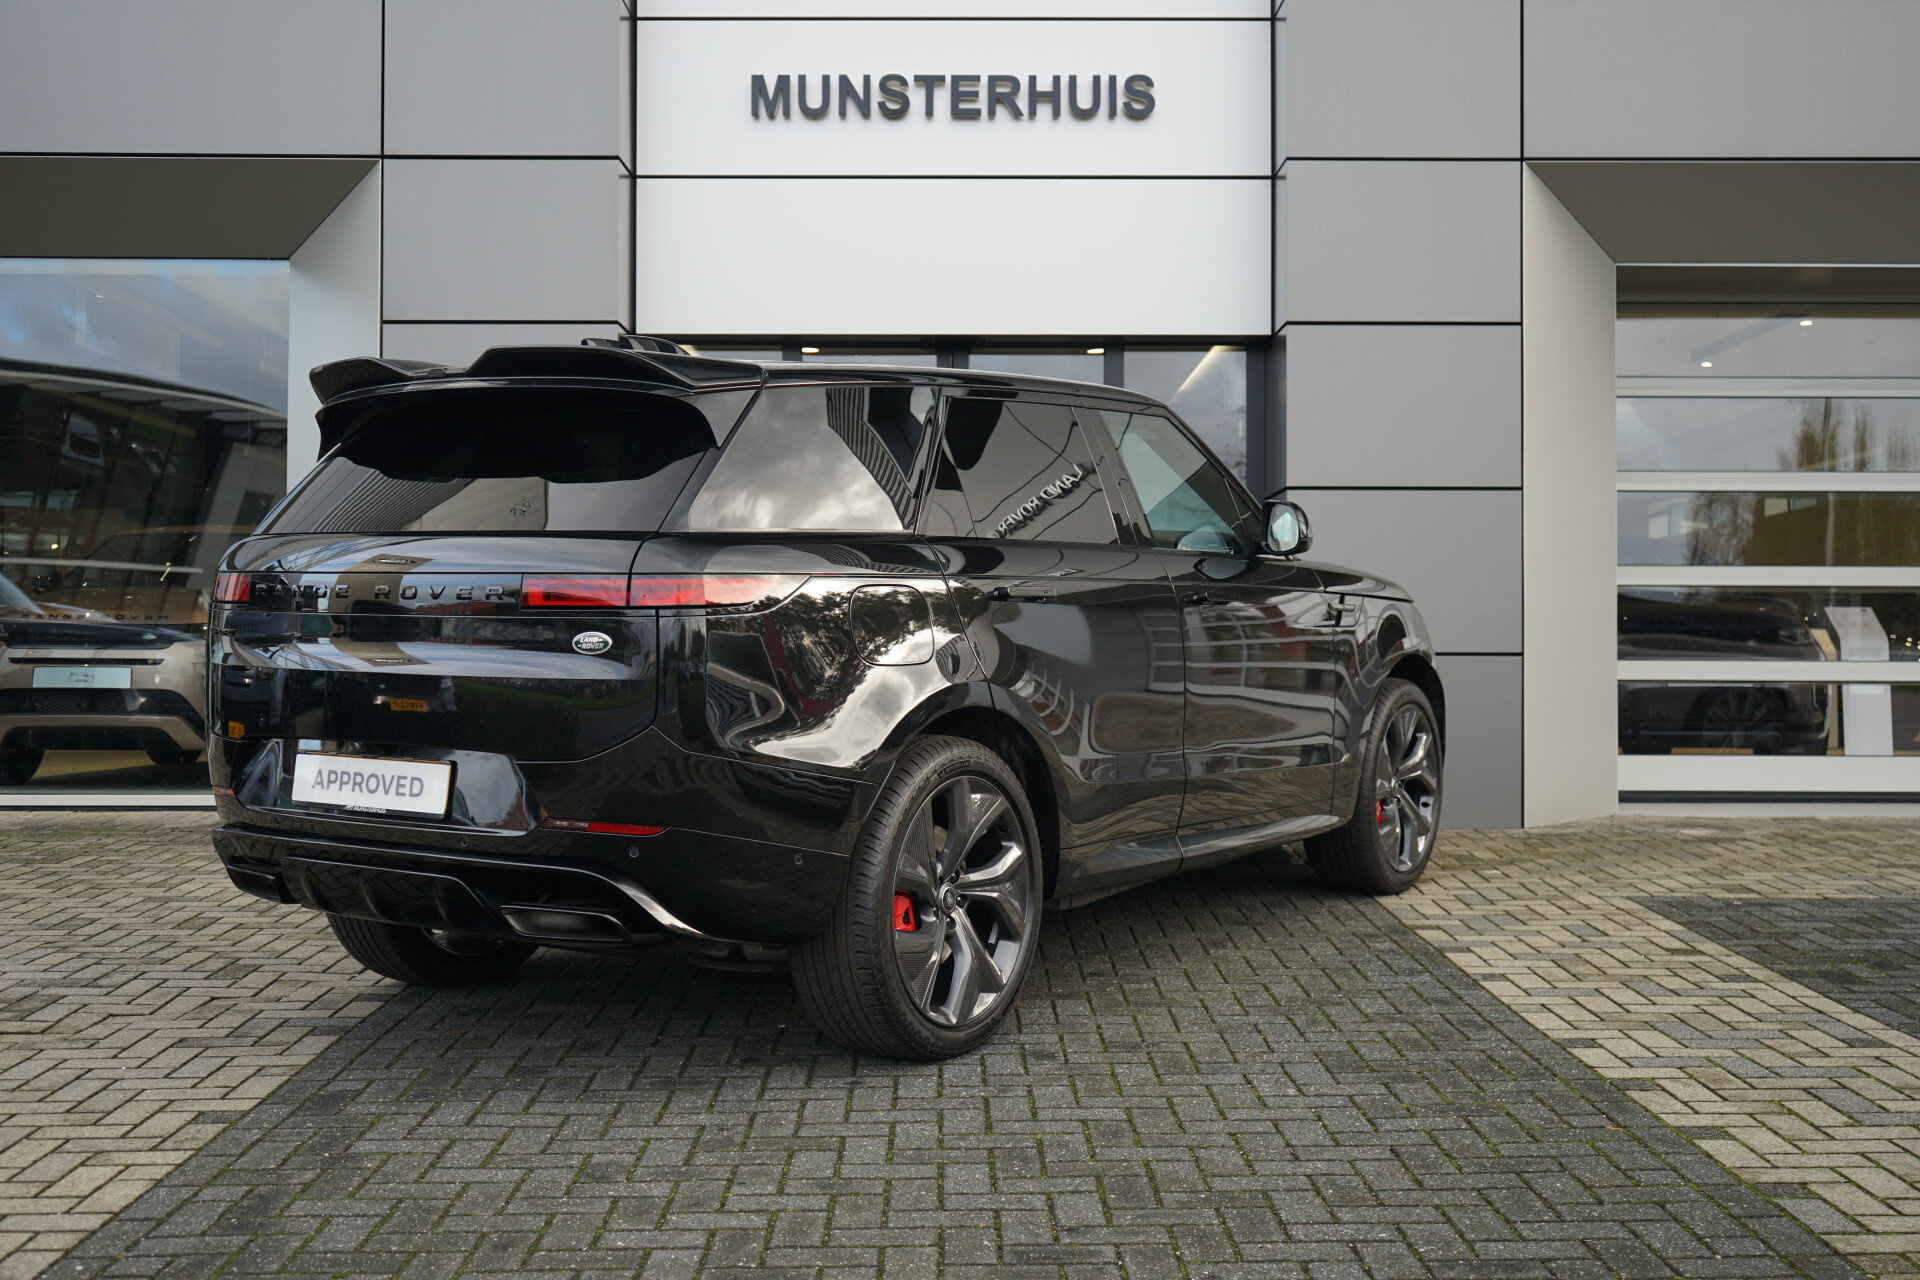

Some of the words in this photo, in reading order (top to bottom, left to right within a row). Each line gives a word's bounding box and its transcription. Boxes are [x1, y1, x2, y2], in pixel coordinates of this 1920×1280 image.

[750, 73, 1157, 120] MUNSTERHUIS
[374, 585, 505, 600] ROVER
[312, 769, 424, 798] APPROVED
